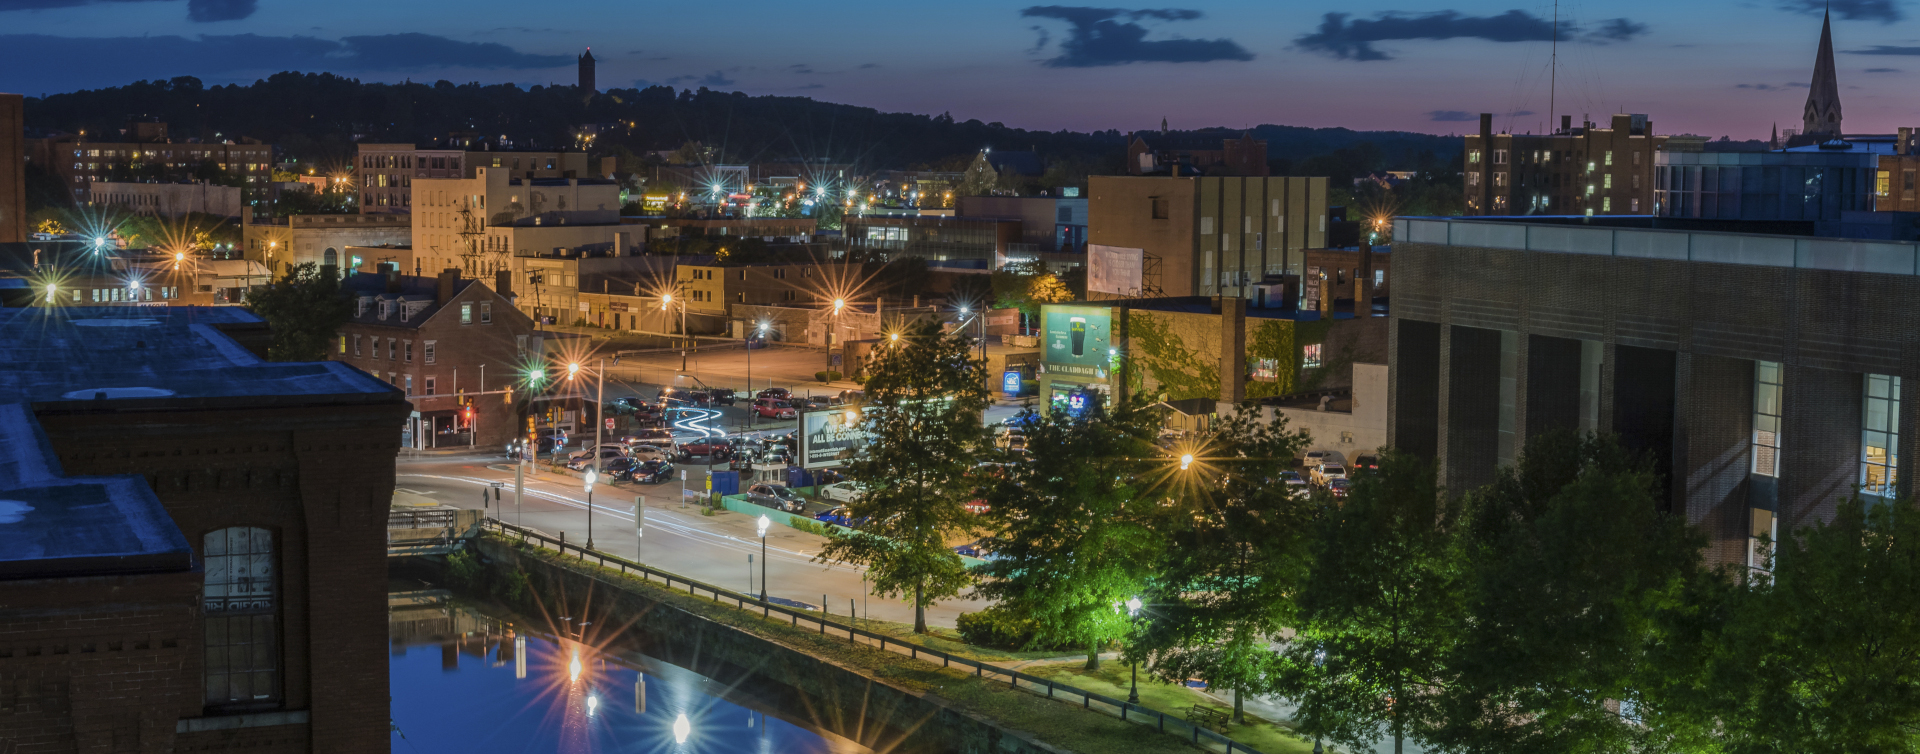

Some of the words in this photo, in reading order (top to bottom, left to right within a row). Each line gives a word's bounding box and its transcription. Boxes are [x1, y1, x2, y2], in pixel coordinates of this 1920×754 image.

[1048, 364, 1061, 372] THE
[1061, 366, 1094, 375] CLADDAGH
[1094, 368, 1108, 376] PB
[825, 425, 837, 434] WE
[812, 434, 826, 444] ALL
[826, 433, 836, 442] BE
